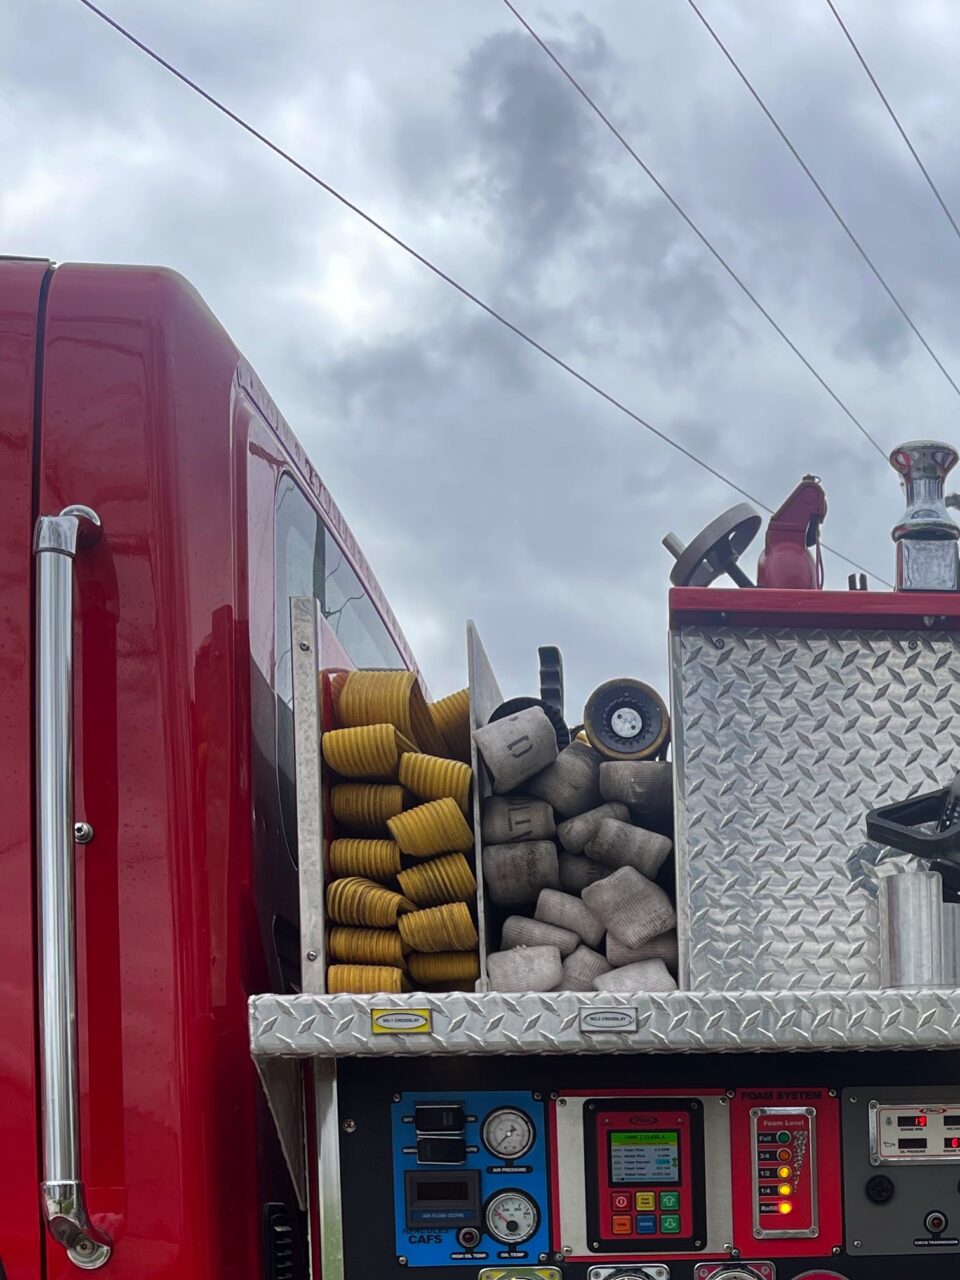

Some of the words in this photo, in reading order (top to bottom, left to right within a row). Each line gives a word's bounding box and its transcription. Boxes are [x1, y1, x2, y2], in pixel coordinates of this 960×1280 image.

[741, 1092, 773, 1100] FOAM
[776, 1091, 821, 1099] SYSTEM
[408, 1235, 442, 1245] CAFS
